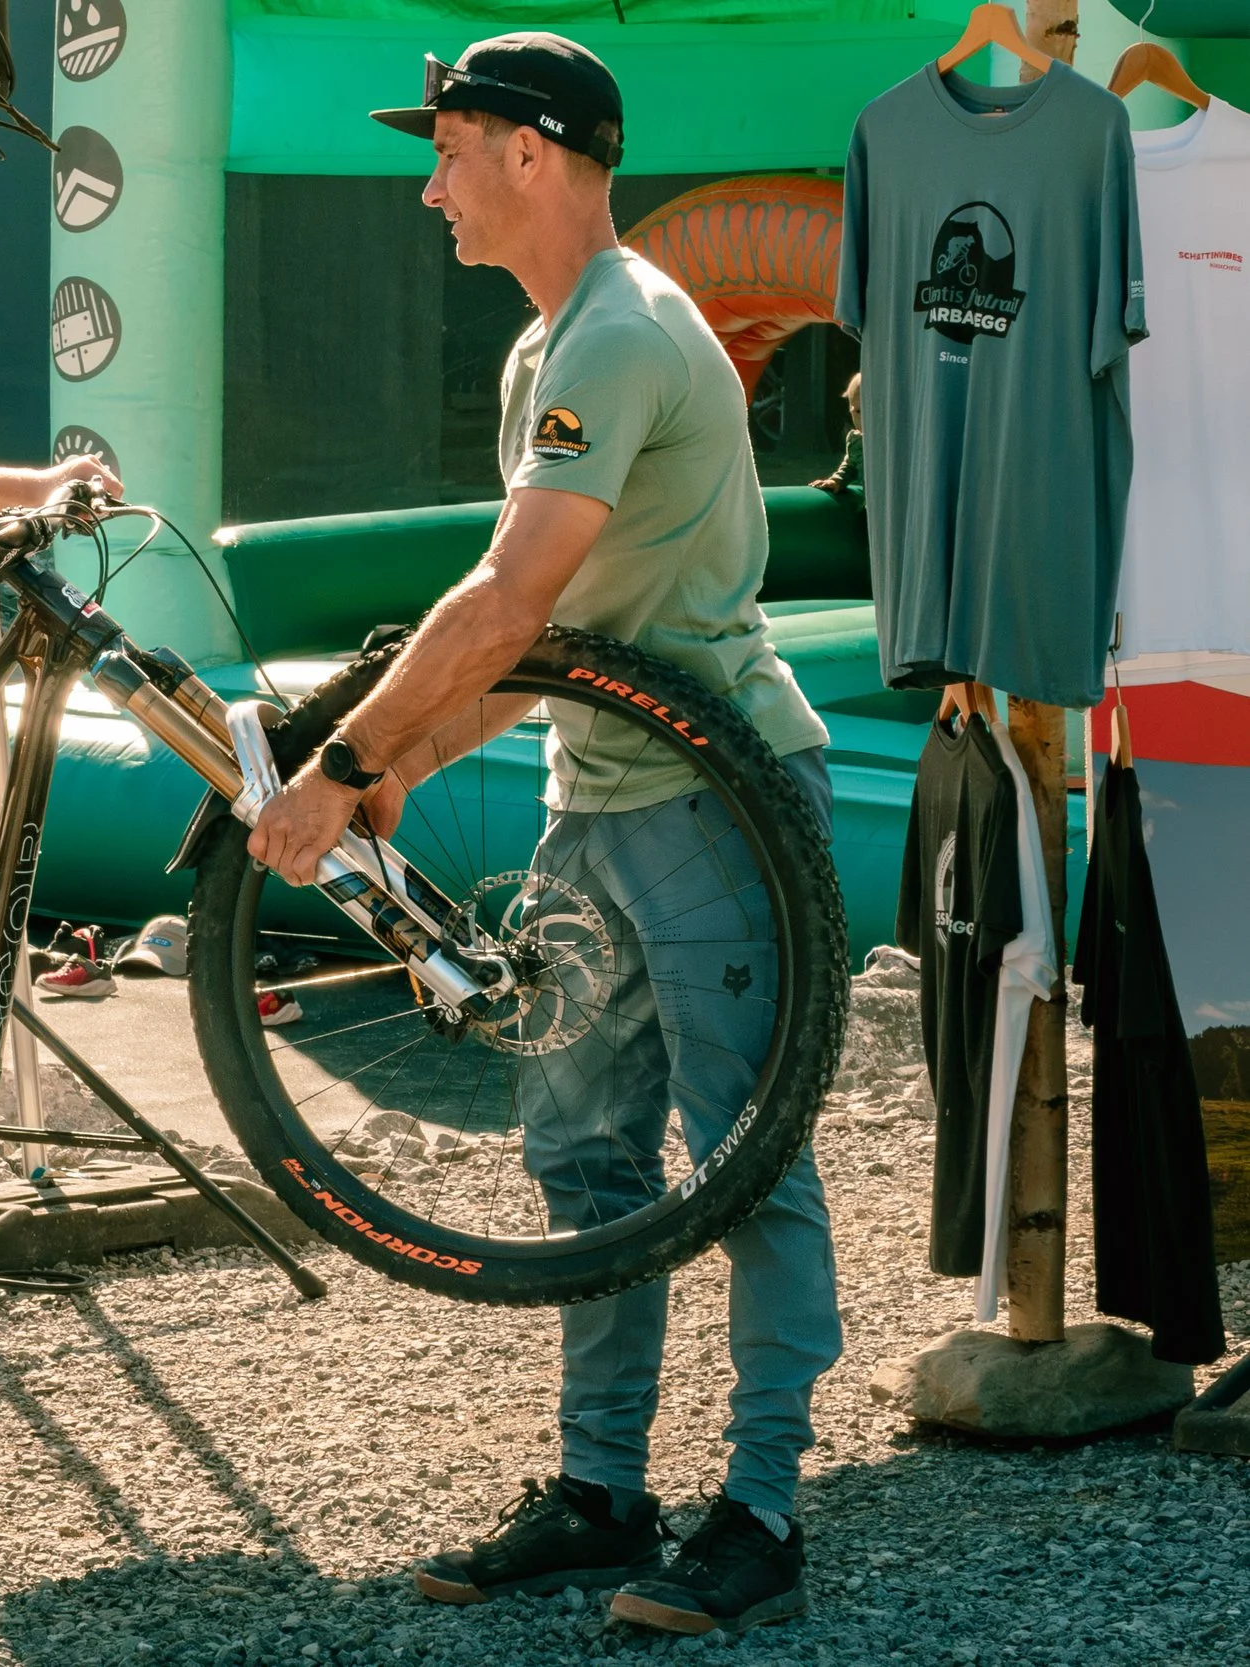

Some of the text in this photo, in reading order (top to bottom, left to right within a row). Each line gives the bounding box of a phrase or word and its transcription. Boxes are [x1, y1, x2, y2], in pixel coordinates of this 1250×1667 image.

[938, 351, 969, 364] Since
[566, 667, 710, 746] PIRELLI
[680, 1098, 758, 1201] DT SWISS
[312, 1190, 484, 1276] SCORPION
